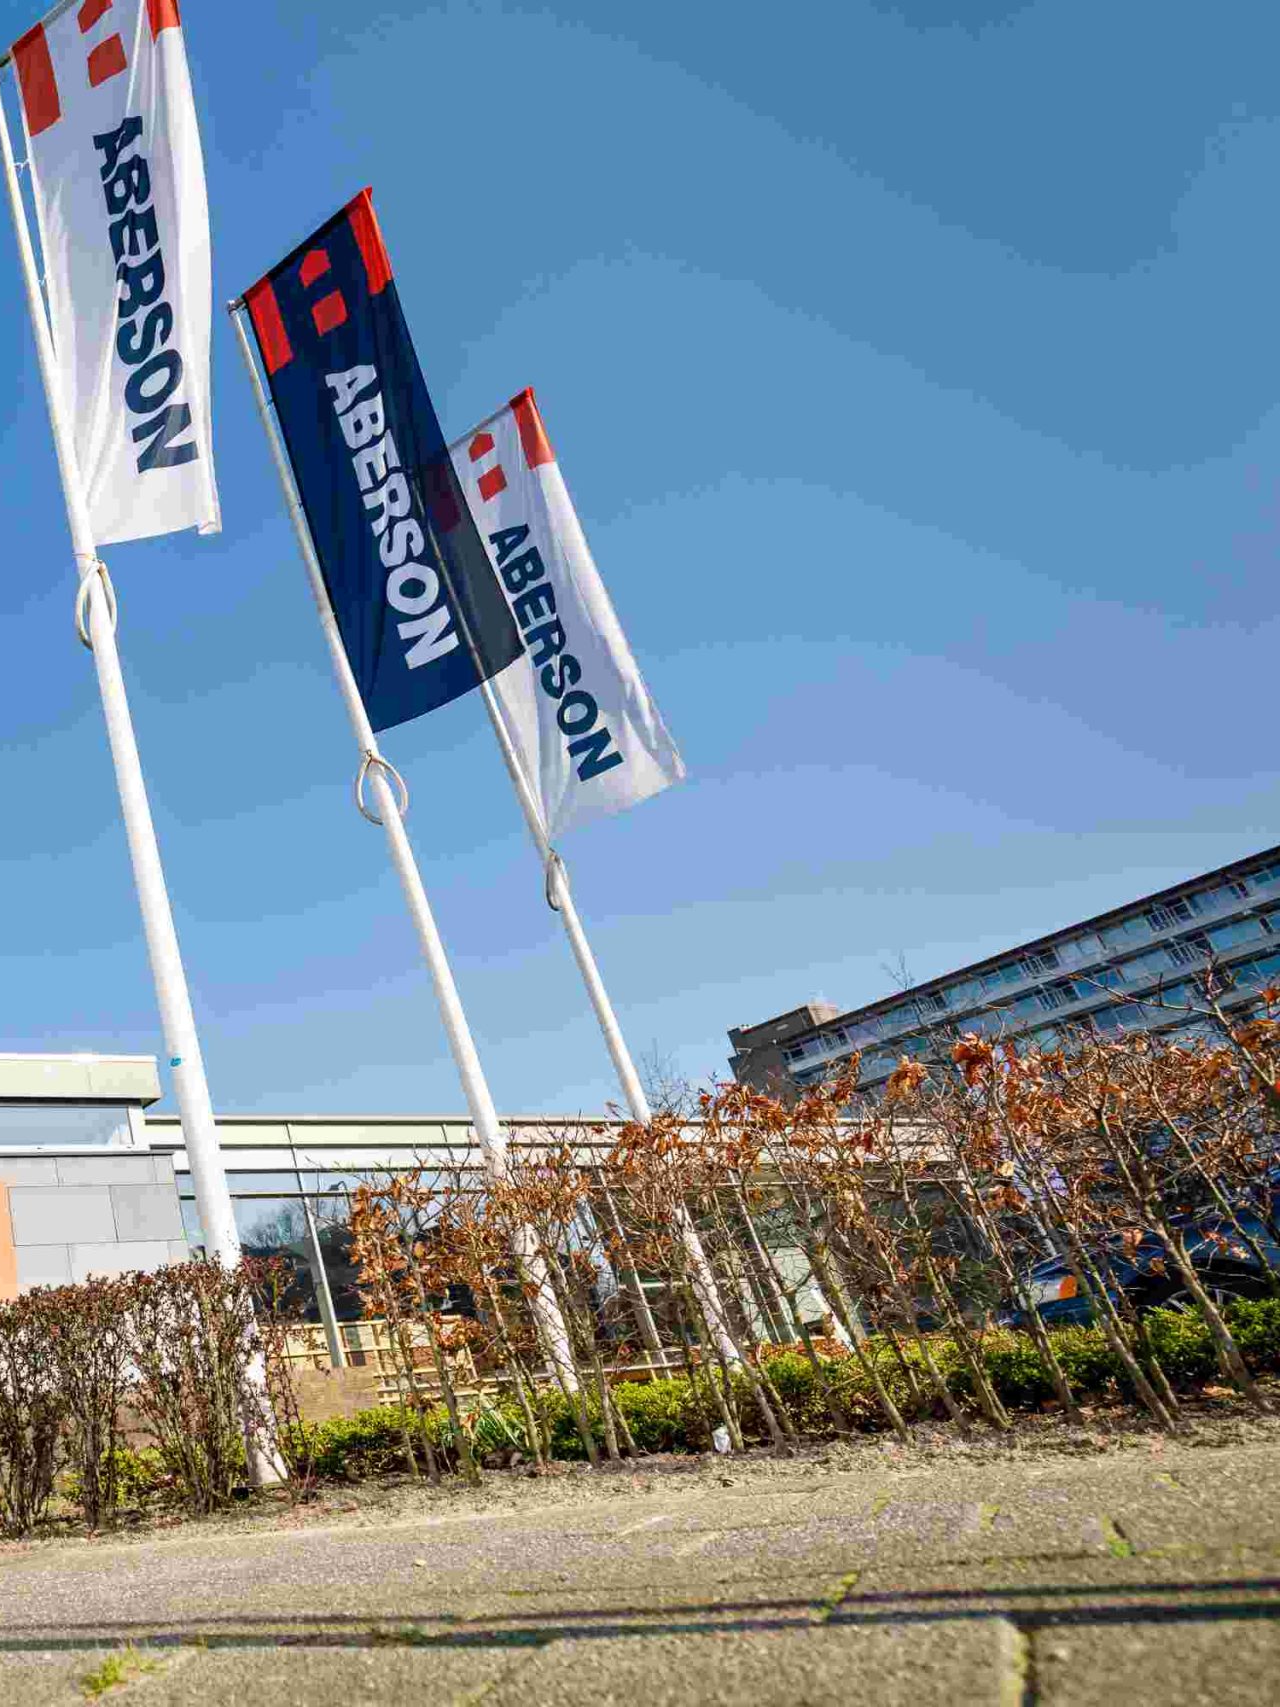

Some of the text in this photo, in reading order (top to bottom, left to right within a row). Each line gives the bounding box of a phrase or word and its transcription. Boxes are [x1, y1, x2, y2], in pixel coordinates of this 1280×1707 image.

[93, 115, 198, 474] ABERSON
[325, 363, 459, 671] ABERSON
[488, 523, 624, 782] ABERSON
